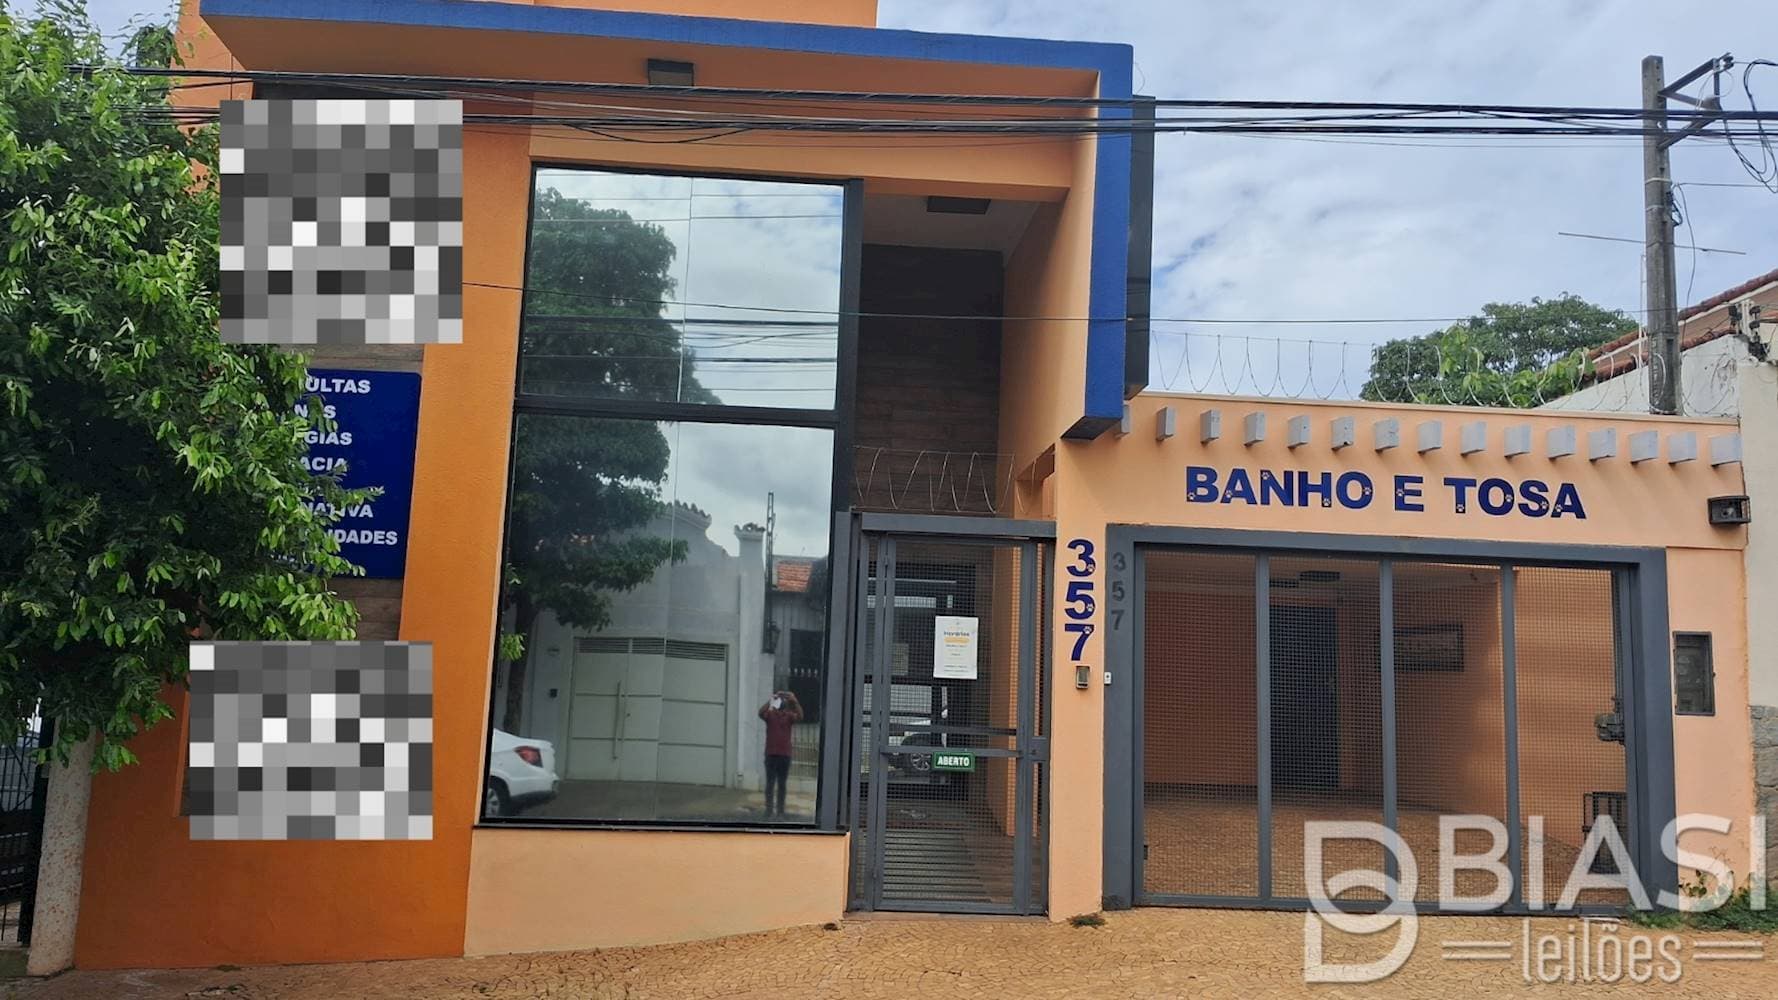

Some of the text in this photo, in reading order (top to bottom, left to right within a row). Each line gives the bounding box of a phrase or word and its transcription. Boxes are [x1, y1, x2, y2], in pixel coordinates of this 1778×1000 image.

[304, 377, 372, 394] ULTAS
[293, 403, 337, 420] NS
[303, 430, 353, 446] GIAS
[300, 456, 348, 473] ACIA
[1185, 465, 1588, 520] BANHO E TOSA
[300, 501, 374, 518] NATIVA
[1111, 551, 1126, 631] 357
[1064, 538, 1097, 662] 357
[936, 755, 971, 768] ABERTO
